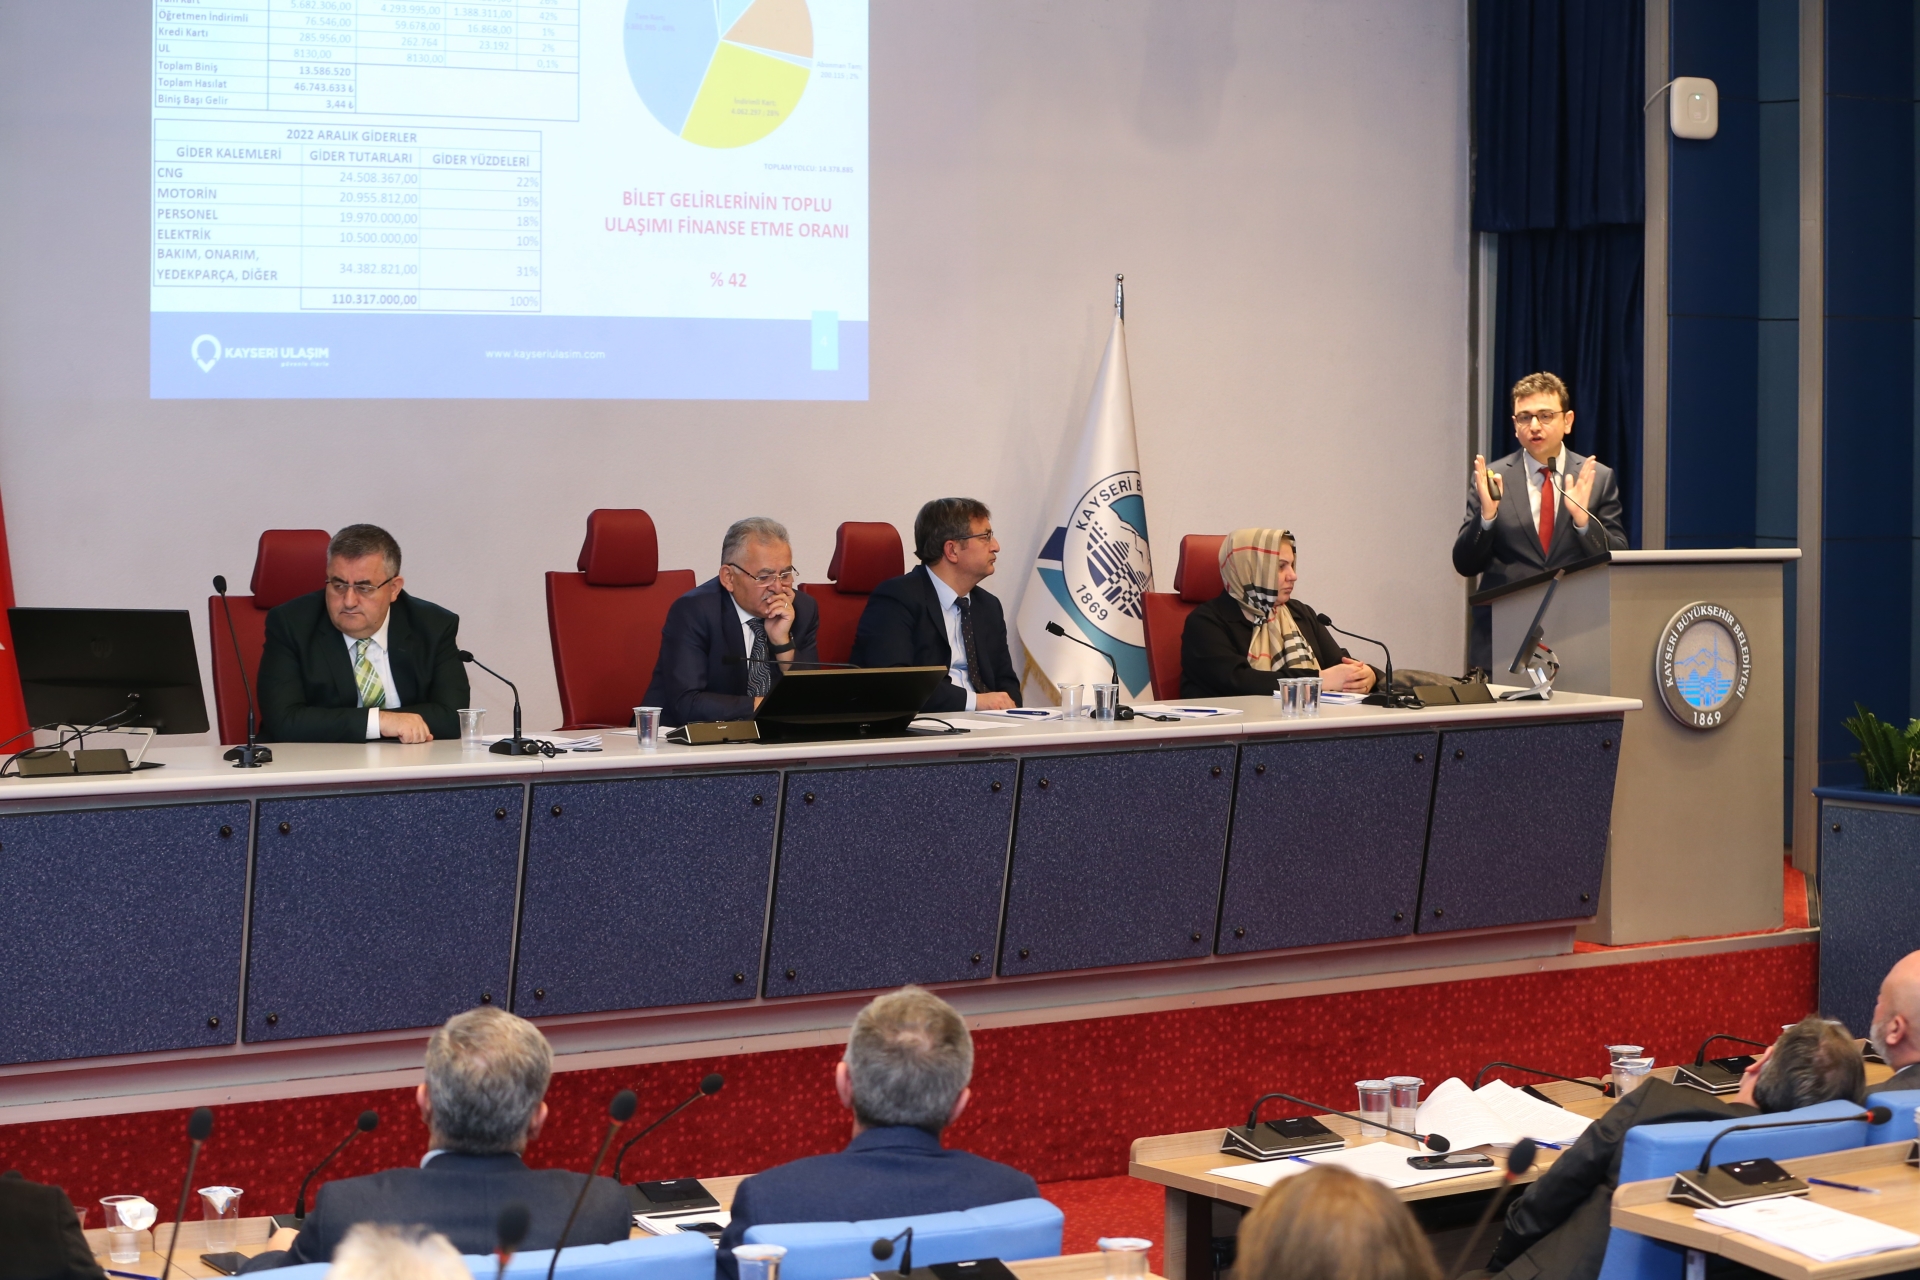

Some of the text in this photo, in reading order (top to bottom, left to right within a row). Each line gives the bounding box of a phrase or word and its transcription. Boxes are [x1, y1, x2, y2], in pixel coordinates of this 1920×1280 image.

[158, 8, 249, 22] Öğretmen İndirimli
[381, 4, 440, 15] 4.293.995,00
[454, 7, 512, 19] 1.388.311,00
[540, 11, 558, 20] 42%
[305, 16, 351, 27] 76.546,00
[395, 20, 440, 32] 59.678,00
[158, 27, 209, 38] Kredi Kartı
[468, 24, 512, 35] 16.868,00
[542, 28, 555, 37] 1%
[299, 32, 351, 44] 285.956,00
[401, 37, 438, 47] 262.764
[158, 44, 170, 53] UL
[479, 41, 510, 51] 23.192
[542, 43, 555, 53] 2%
[293, 49, 332, 60] 8130,00
[406, 53, 444, 64] 8130,00
[158, 61, 218, 73] Toplam Biniş
[299, 66, 351, 76] 13.586.520
[158, 78, 227, 89] Toplam Hasılat
[294, 82, 346, 93] 46.743.633
[158, 94, 229, 106] Biniş Başı Gelir
[326, 100, 346, 110] 3,44
[286, 129, 418, 143] 2022 ARALIK GİDERLER
[176, 144, 282, 160] GİDER KALEMLERİ
[309, 148, 413, 164] GİDER TUTARLARI
[432, 152, 531, 167] GİDER YÜZDELERİ
[157, 167, 183, 179] CNG
[764, 163, 792, 171] TOPLAM
[339, 172, 418, 185] 24.508.367,00
[516, 177, 539, 188] 22%
[157, 187, 217, 199] MOTORİN
[339, 192, 418, 206] 20.955.812,00
[516, 196, 539, 207] 19%
[623, 187, 833, 213] BİLET GELİRLERİNİN TOPLU
[157, 208, 219, 220] PERSONEL
[339, 212, 418, 225] 19.970.000,00
[516, 216, 539, 227] 18%
[604, 216, 849, 239] ULAŞIMI FİNANSE ETME ORANI
[157, 227, 212, 240] ELEKTRİK
[339, 232, 418, 245] 10.500.000,00
[516, 236, 539, 247] 10%
[157, 248, 260, 262] BAKIM, ONARIM,
[156, 267, 279, 283] YEDEKPARÇA, DİĞER
[339, 263, 418, 277] 34.382.821,00
[516, 266, 539, 277] 31%
[710, 272, 748, 288] % 42
[331, 294, 418, 306] 110.317.000,00
[509, 296, 539, 307] 100%
[280, 347, 330, 360] ULAŞIM
[485, 348, 606, 360] www.kayseriulasim.com
[1076, 476, 1133, 531] KAYSERİ
[1075, 584, 1108, 621] 1869
[1664, 629, 1679, 688] KAYSERİ
[1676, 605, 1735, 633] BÜYÜKŞEHİR
[1693, 711, 1721, 726] 1869
